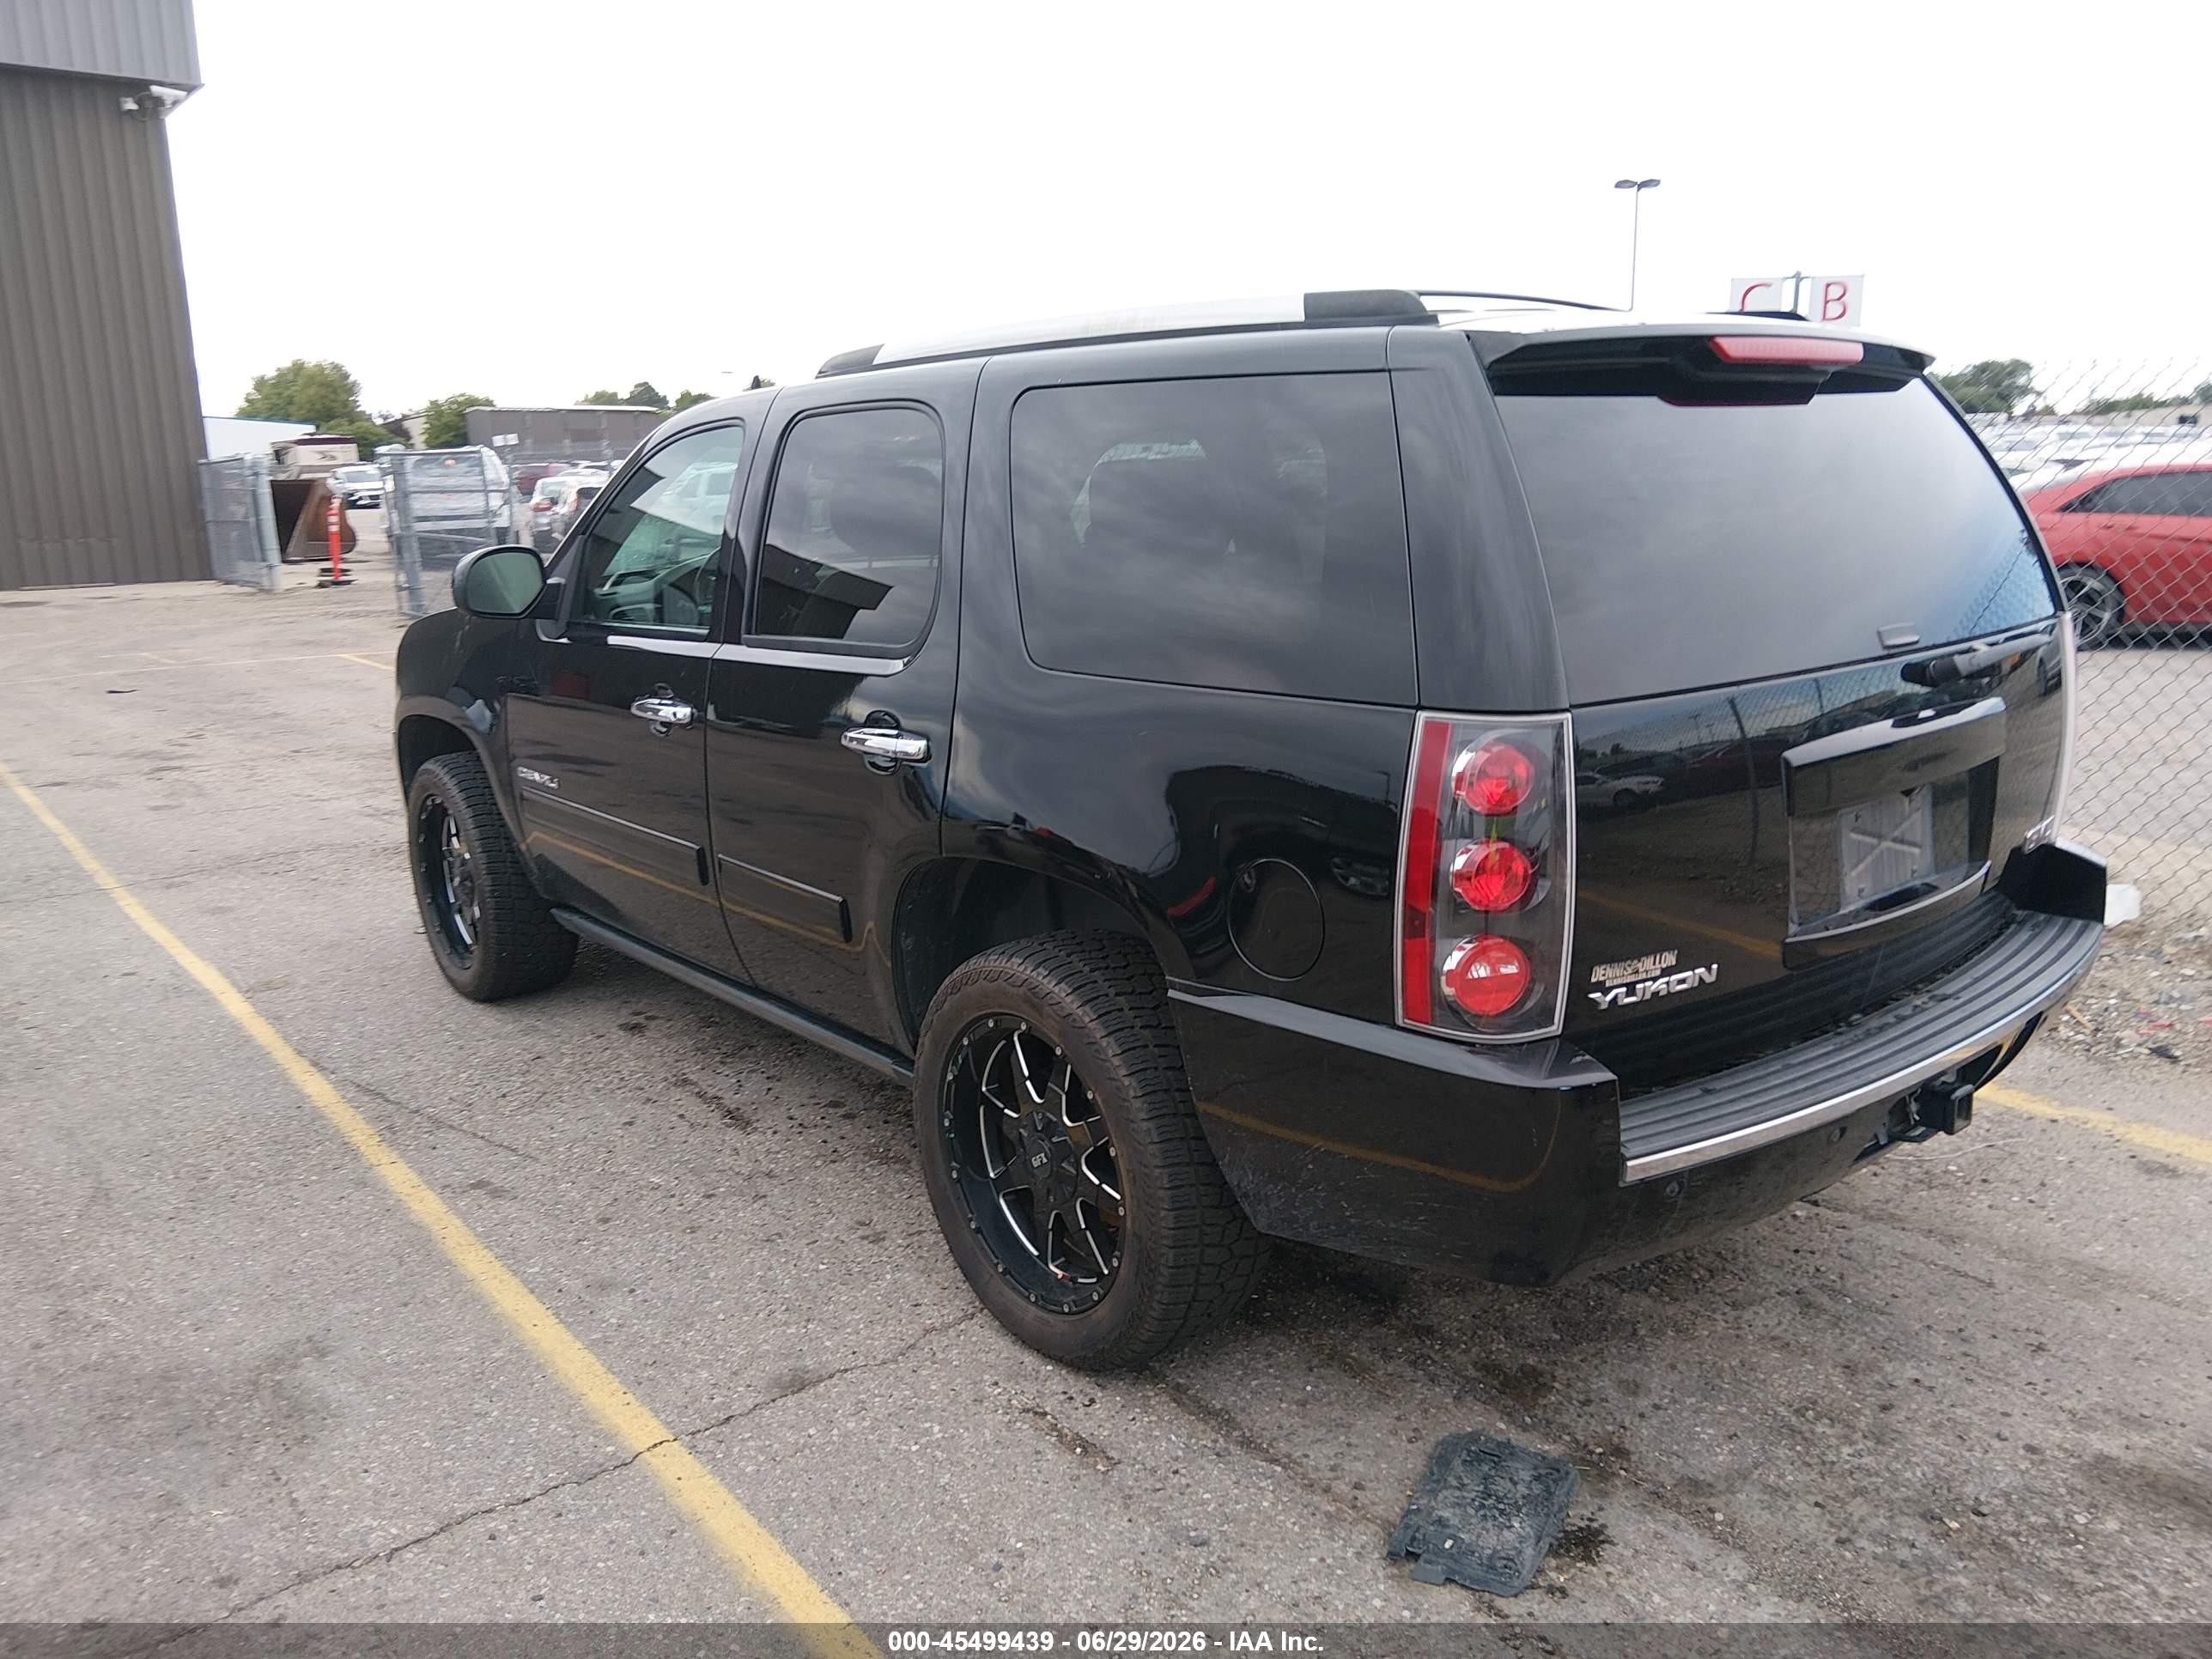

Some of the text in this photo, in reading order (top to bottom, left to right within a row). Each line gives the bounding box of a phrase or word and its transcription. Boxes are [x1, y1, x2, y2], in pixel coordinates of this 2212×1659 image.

[1822, 281, 1849, 321] B
[1590, 959, 1633, 982] DENNIS
[1638, 949, 1678, 973] DILLON
[1587, 963, 1718, 1010] YUKON
